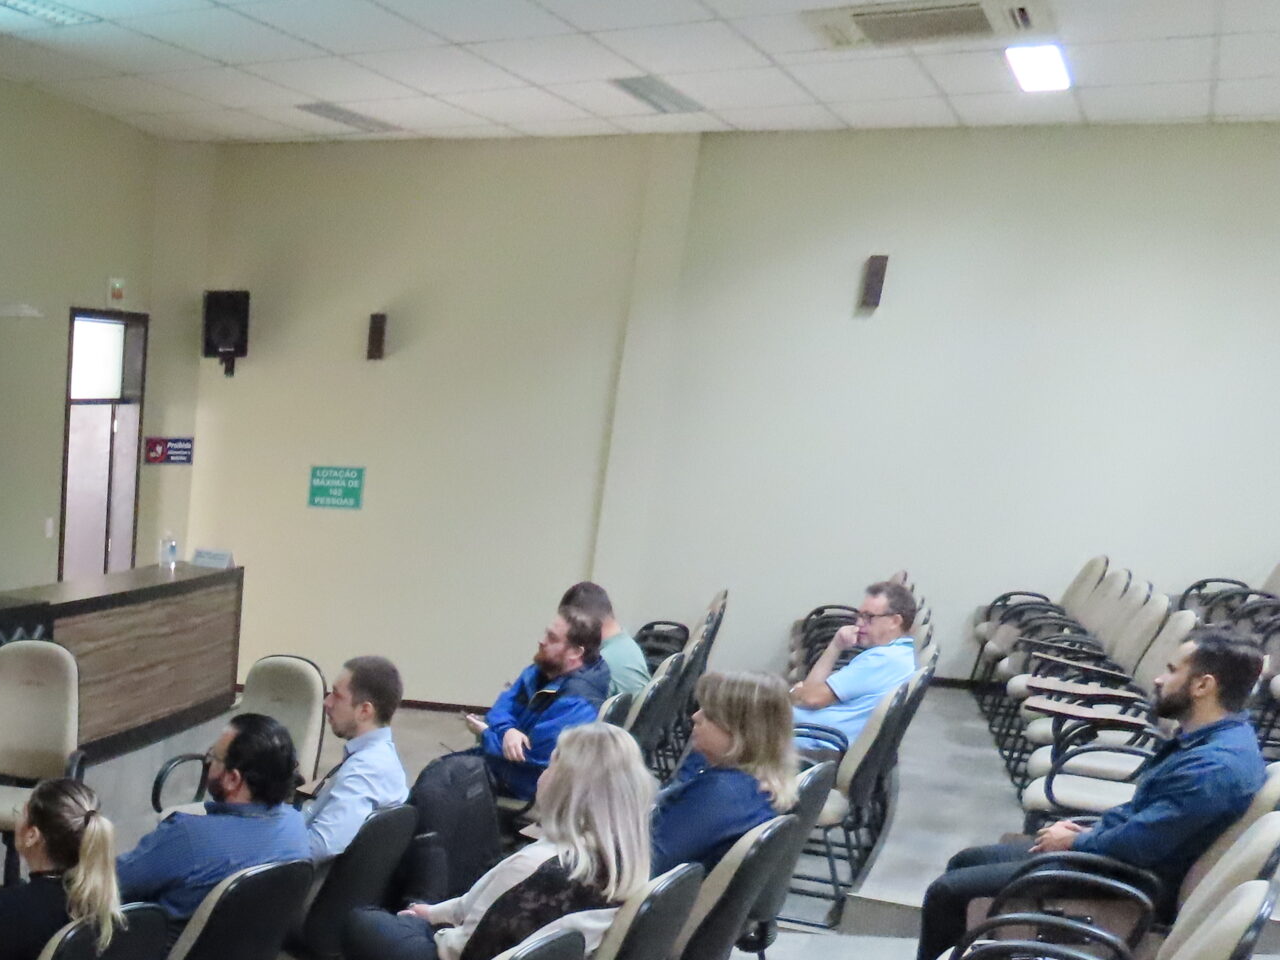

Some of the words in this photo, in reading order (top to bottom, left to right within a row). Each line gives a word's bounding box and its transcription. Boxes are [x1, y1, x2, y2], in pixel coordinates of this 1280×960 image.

[313, 477, 346, 487] MÁXIMA
[348, 479, 359, 488] DE
[314, 496, 354, 506] PESSOAS
